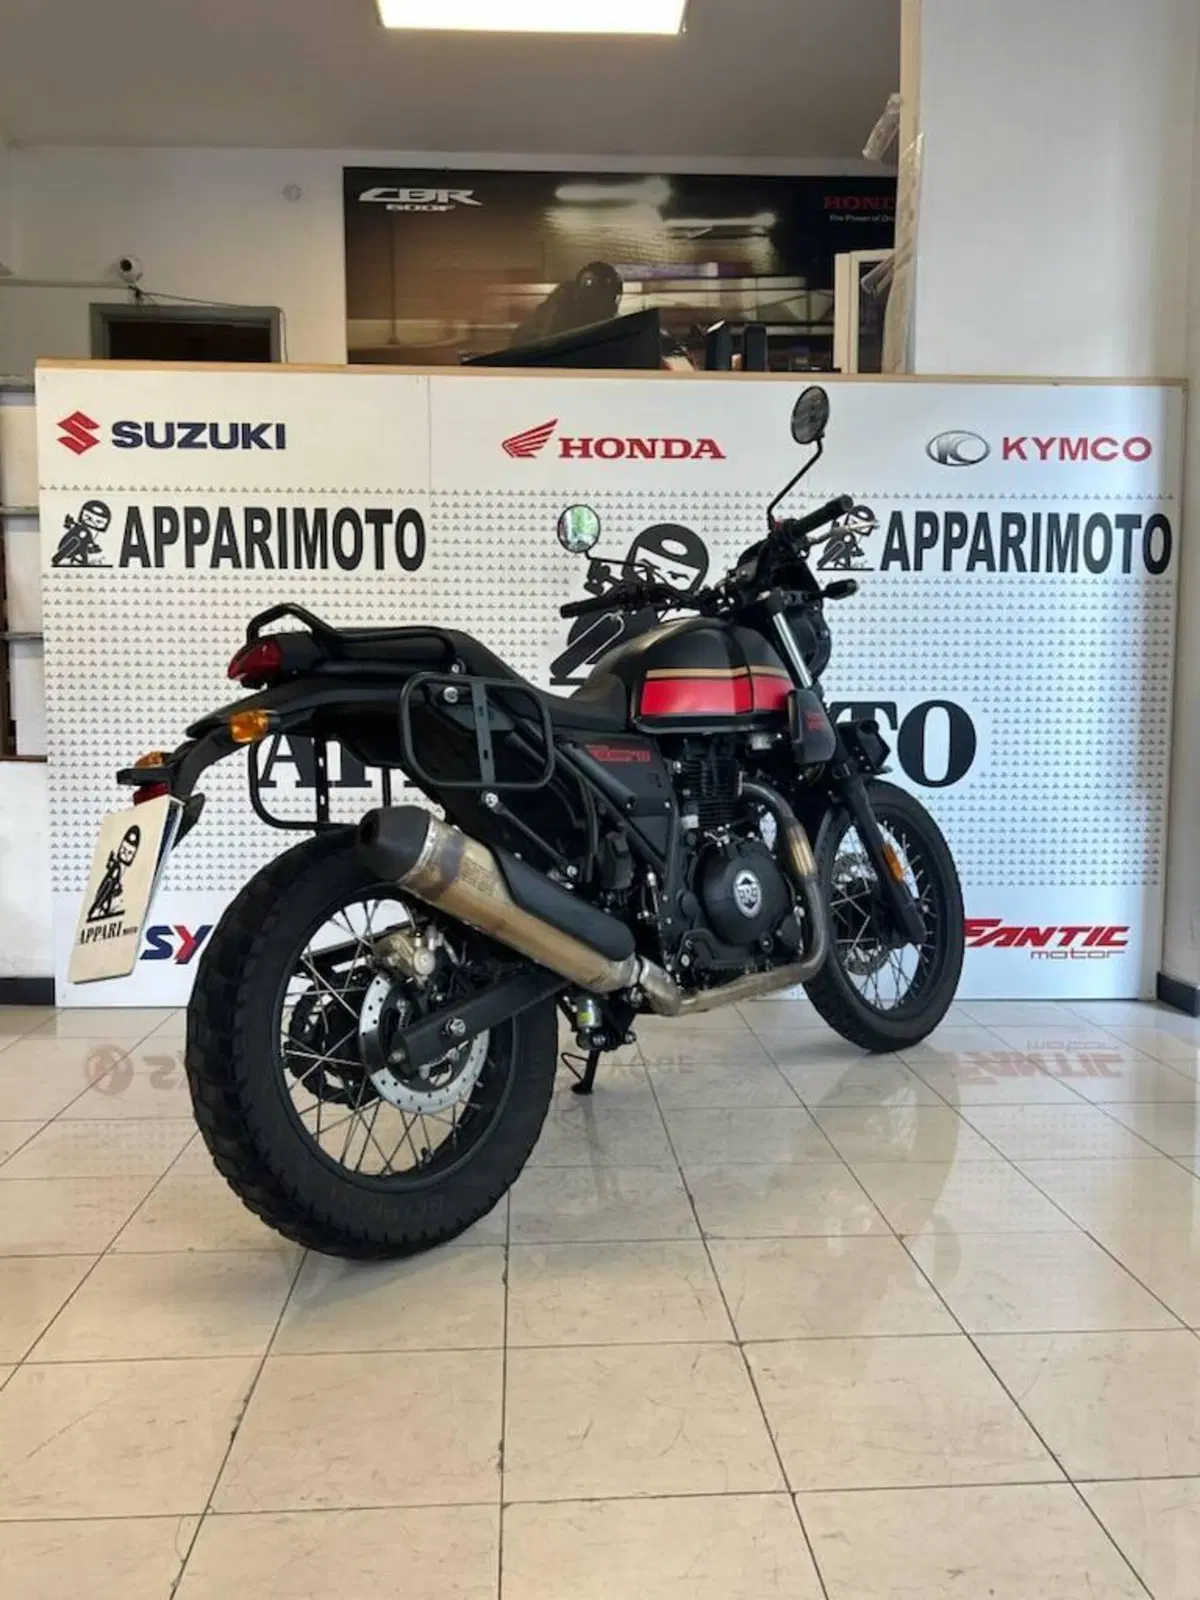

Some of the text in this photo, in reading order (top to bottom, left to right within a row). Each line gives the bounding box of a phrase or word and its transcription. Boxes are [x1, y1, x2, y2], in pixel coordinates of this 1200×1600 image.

[358, 187, 484, 206] CBR
[823, 195, 895, 211] HOND
[111, 421, 287, 450] SUZUKI
[558, 437, 726, 459] HONDA
[1002, 436, 1152, 461] KYMCO
[119, 505, 426, 572] APPARIMOTO
[880, 510, 1173, 575] APPARIMOTO
[140, 925, 214, 965] SY
[963, 918, 1130, 948] FANTIC
[1030, 948, 1125, 960] motor
